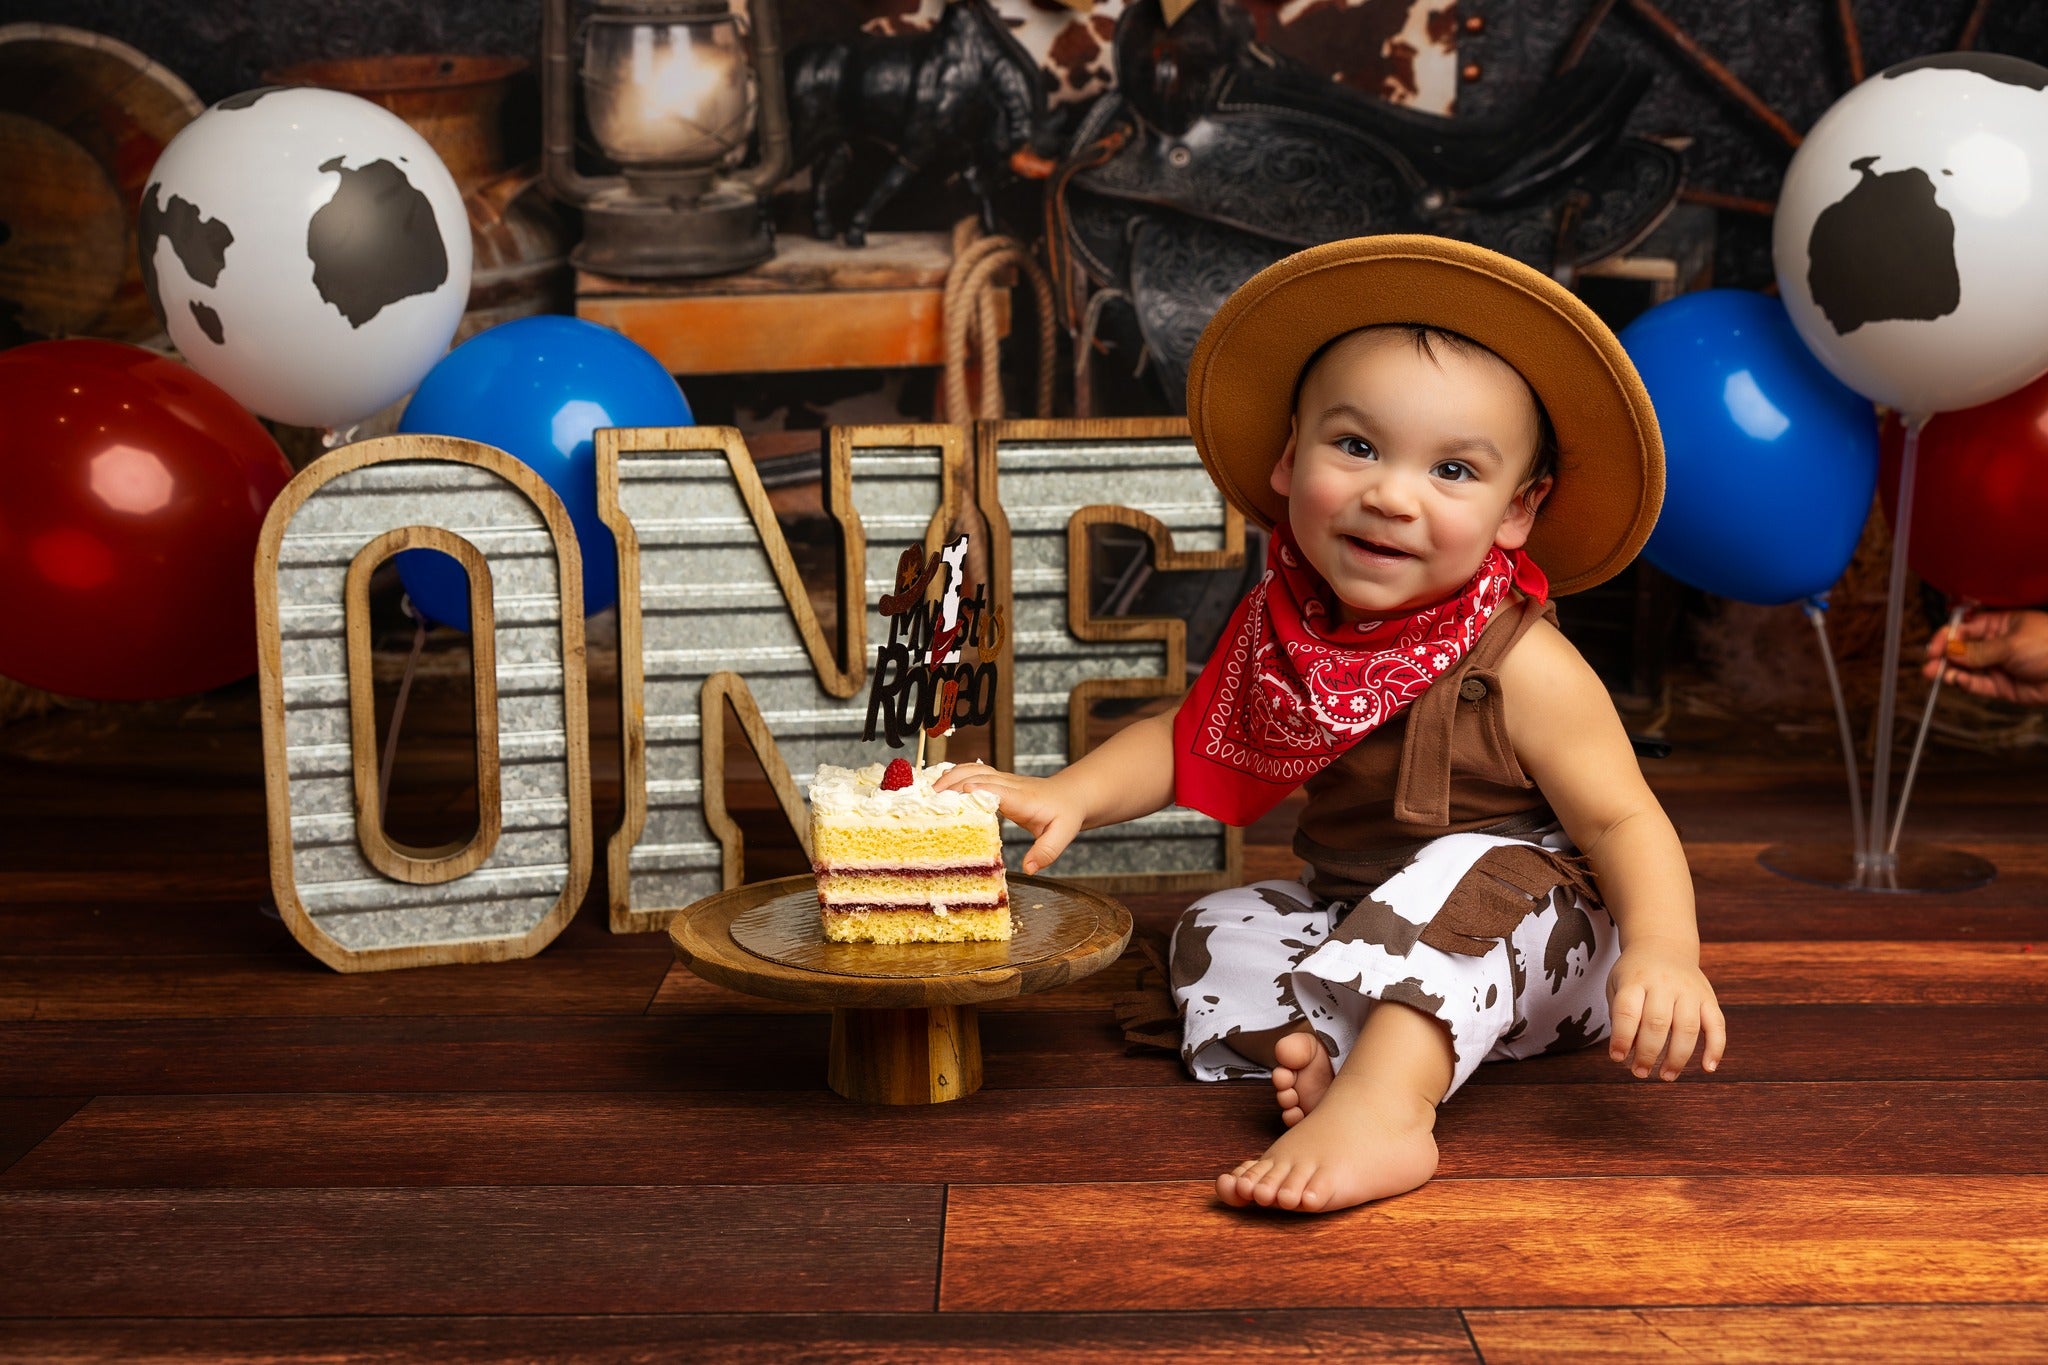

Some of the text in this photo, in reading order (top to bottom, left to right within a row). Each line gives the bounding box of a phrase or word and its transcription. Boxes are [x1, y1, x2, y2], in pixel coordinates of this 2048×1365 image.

[924, 533, 986, 665] 1st
[254, 417, 1245, 973] ONE
[862, 642, 998, 749] Rodeo
